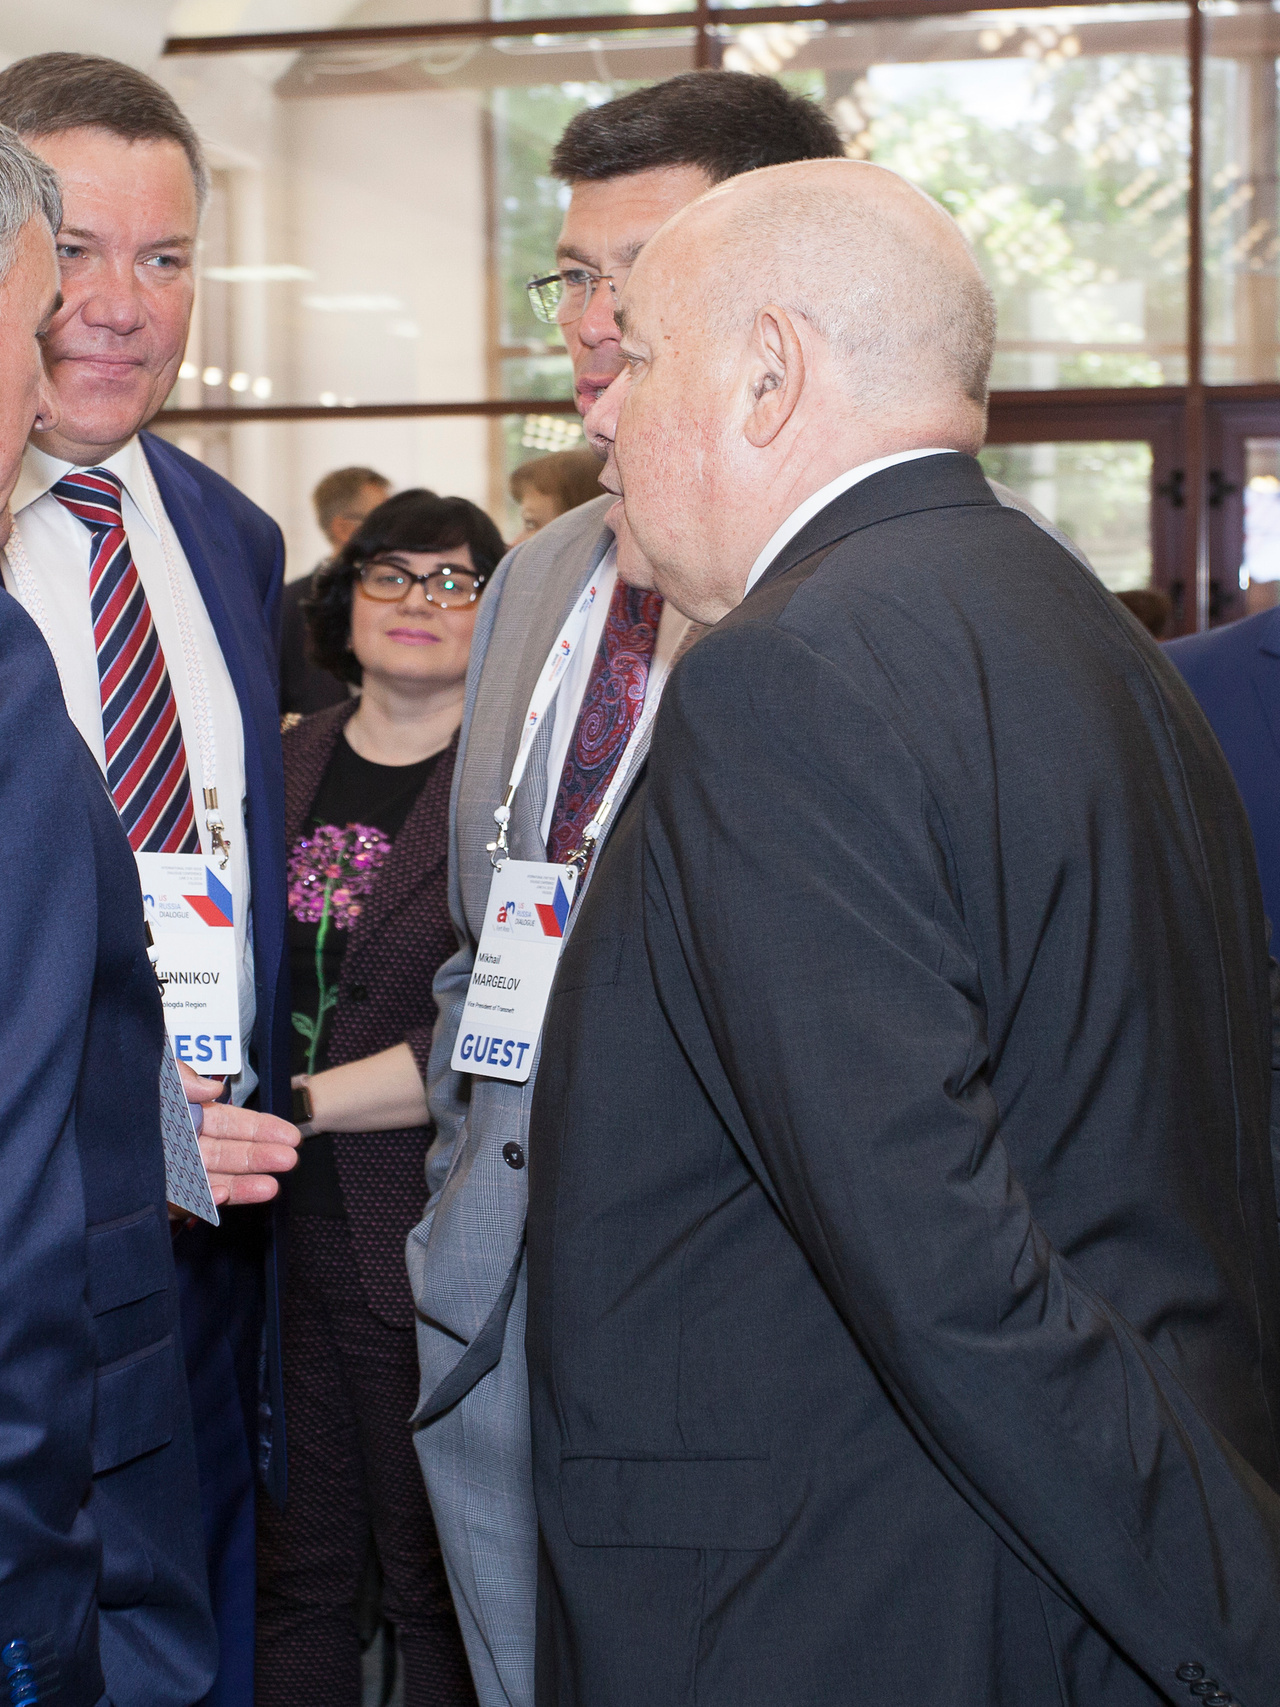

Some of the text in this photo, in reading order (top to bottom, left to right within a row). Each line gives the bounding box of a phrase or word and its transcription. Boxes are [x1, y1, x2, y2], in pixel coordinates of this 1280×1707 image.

[515, 918, 535, 927] DIALOGUE
[478, 953, 501, 965] Mikhail
[472, 973, 520, 991] MARGELOV
[163, 1001, 207, 1009] ologda Region
[475, 1002, 492, 1010] President
[175, 1034, 232, 1062] EST
[460, 1034, 530, 1069] GUEST
